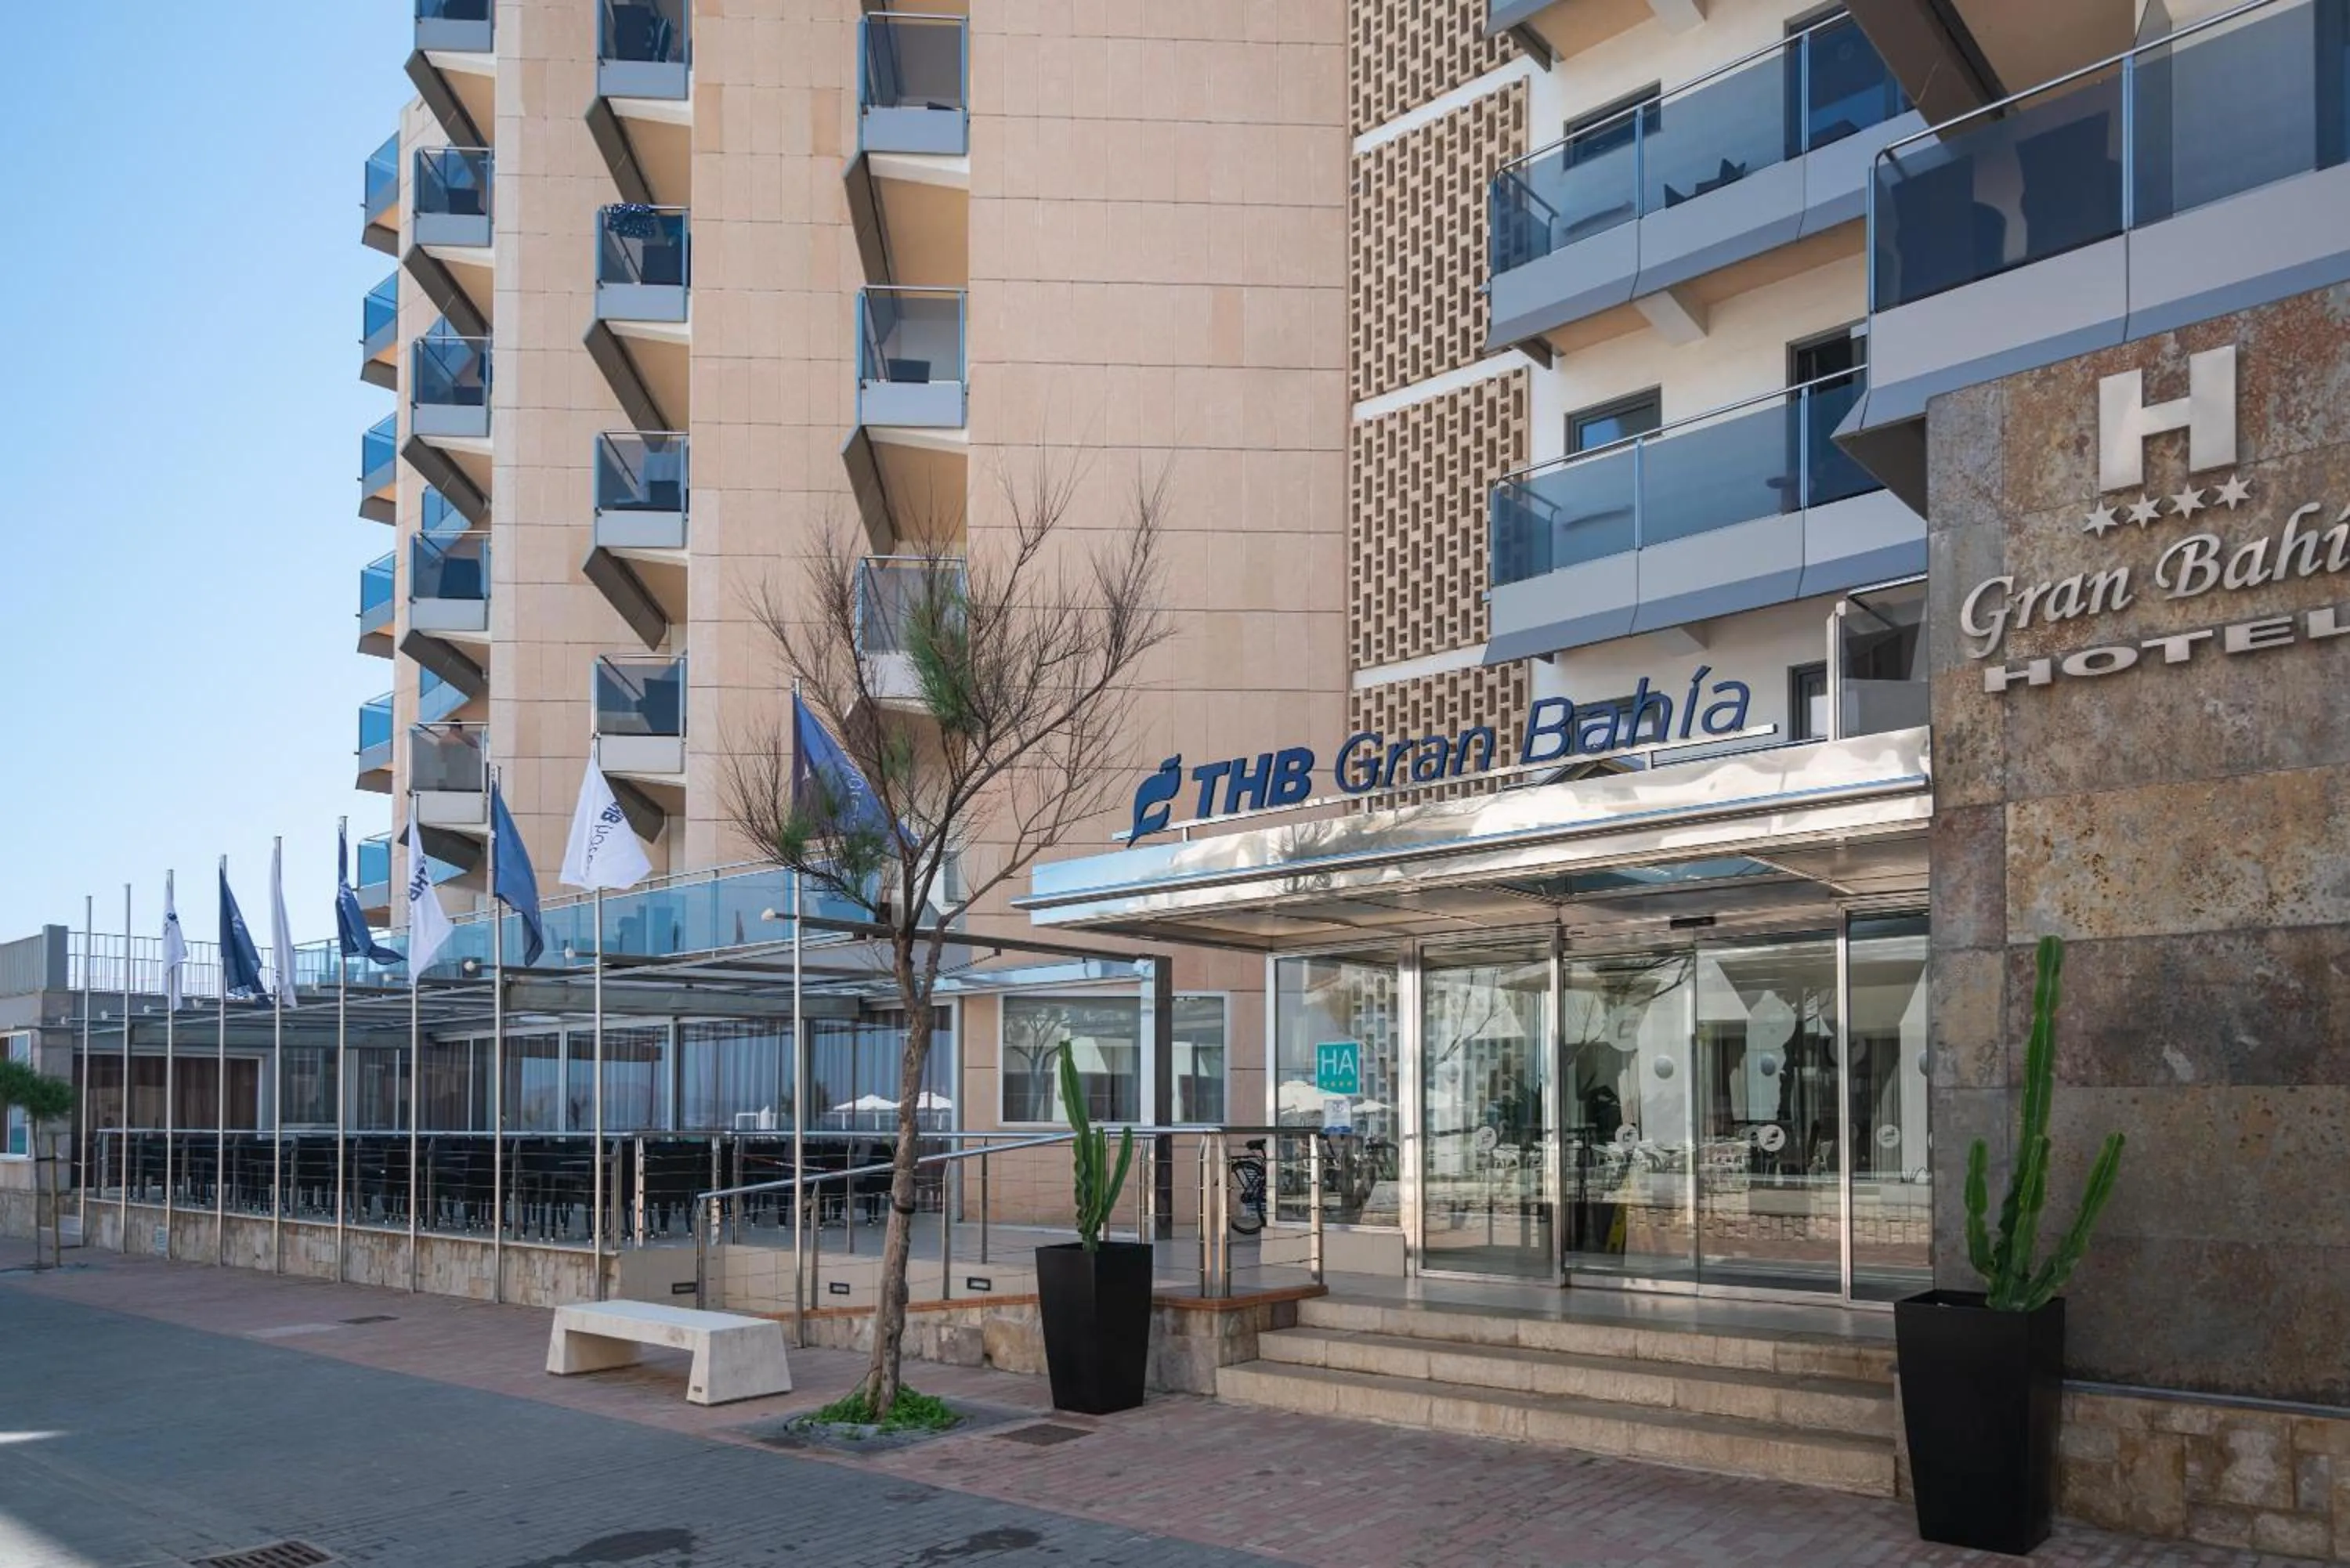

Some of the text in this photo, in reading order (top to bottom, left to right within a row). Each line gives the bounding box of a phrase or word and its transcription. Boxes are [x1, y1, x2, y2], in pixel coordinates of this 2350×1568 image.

[2099, 344, 2237, 493] H
[1960, 565, 2134, 659] Gran
[1984, 607, 2350, 693] HOTEL
[1191, 664, 1752, 820] THB Gran Bahía
[1320, 1048, 1355, 1076] HA
